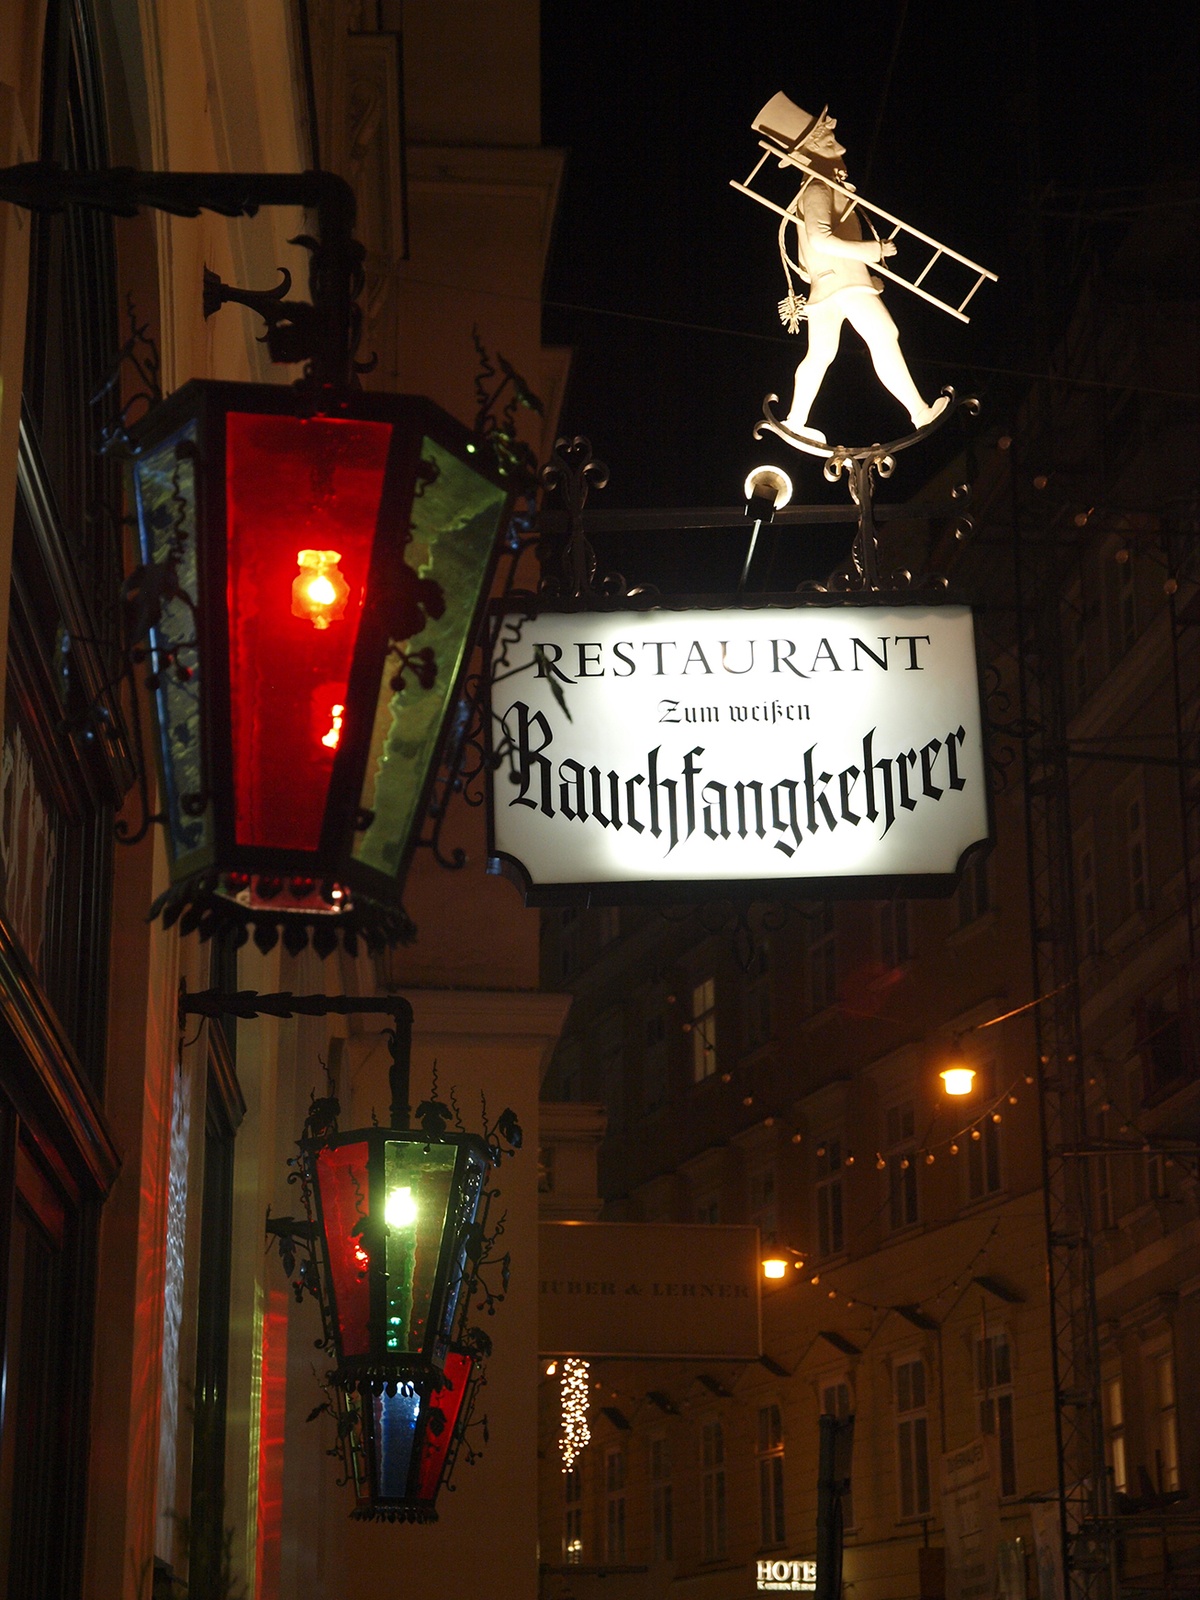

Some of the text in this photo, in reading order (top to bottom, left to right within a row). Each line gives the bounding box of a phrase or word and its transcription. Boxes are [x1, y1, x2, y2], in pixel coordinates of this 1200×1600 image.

[533, 635, 931, 684] RESTAURANT
[656, 699, 811, 725] Zum weißen
[501, 700, 967, 859] Rauchfangkehrer
[756, 1560, 817, 1581] HOTE
